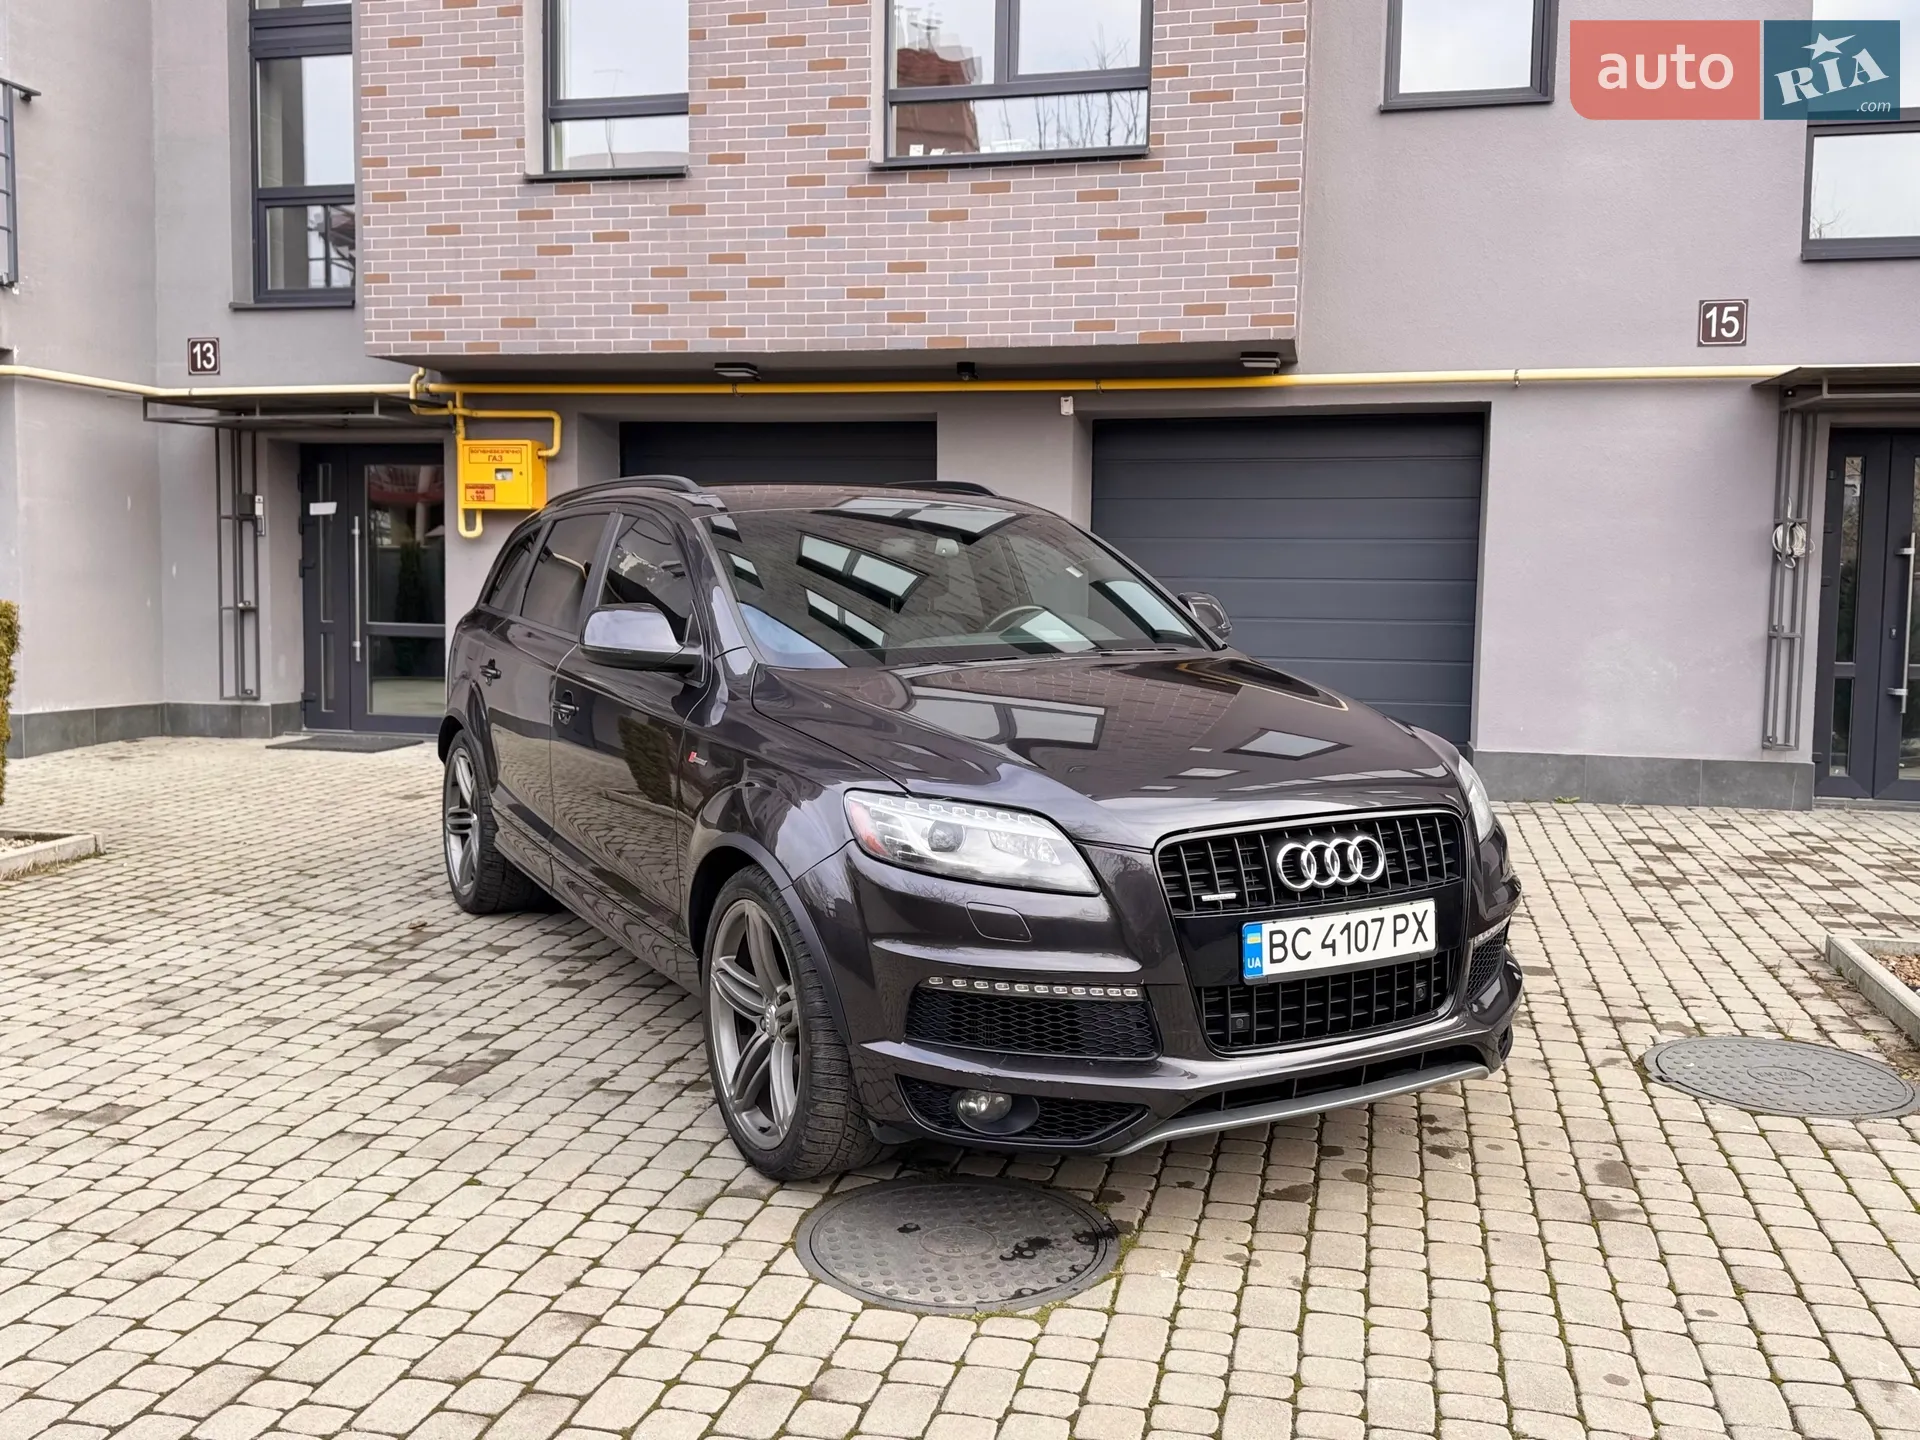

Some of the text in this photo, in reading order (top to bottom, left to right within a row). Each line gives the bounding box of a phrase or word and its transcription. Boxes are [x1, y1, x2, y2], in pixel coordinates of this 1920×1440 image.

[1706, 306, 1740, 338] 15
[193, 342, 215, 369] 13
[1269, 909, 1429, 965] BC 4107 PX
[1247, 957, 1261, 969] UA
